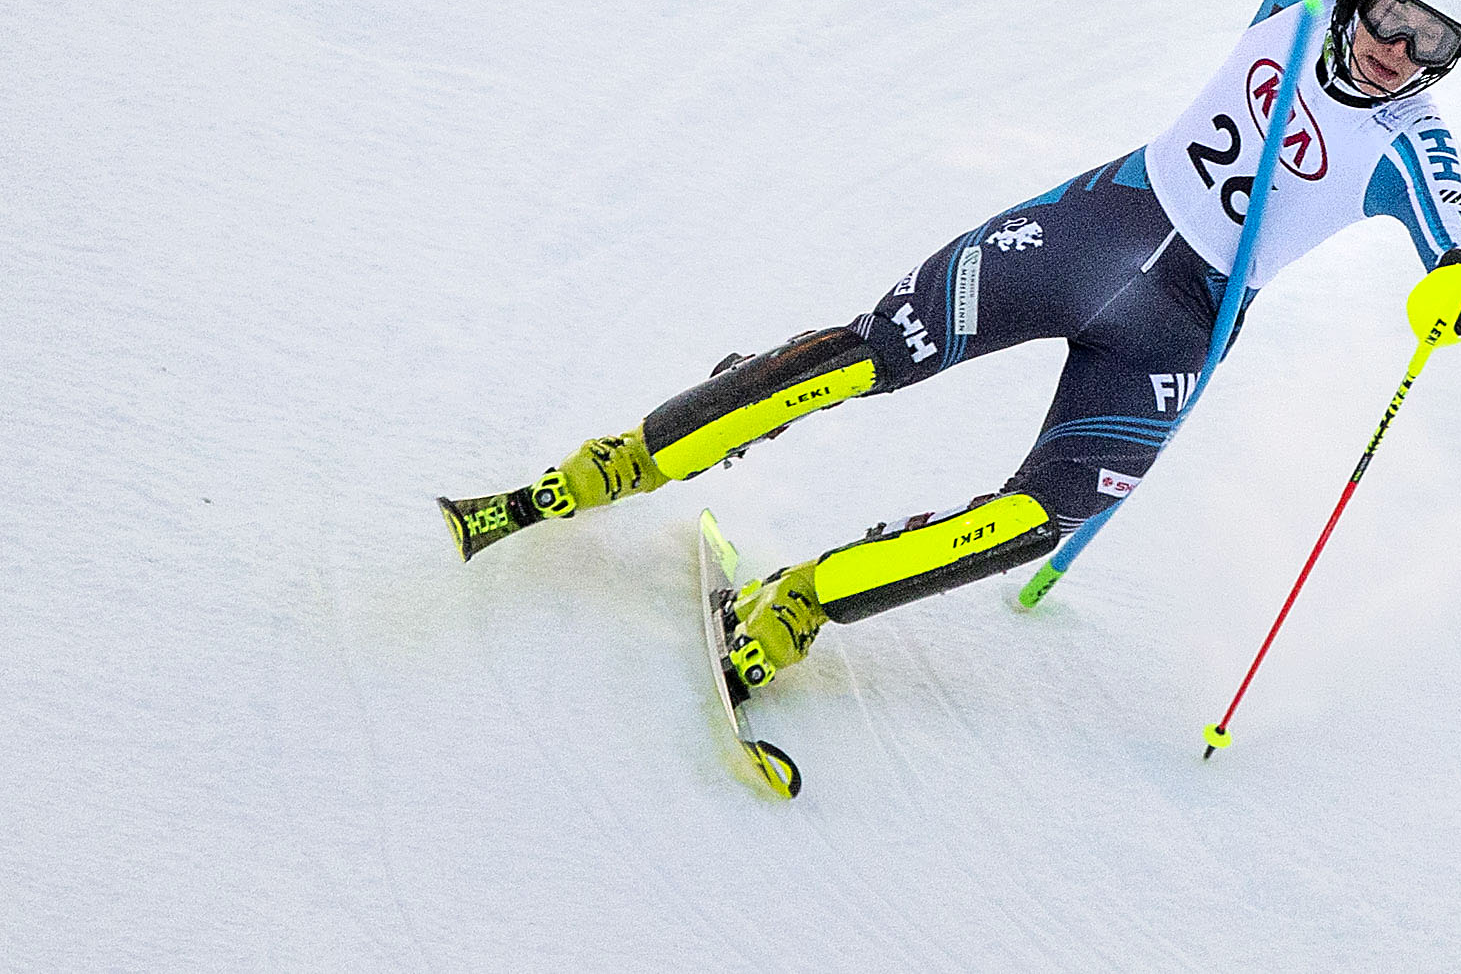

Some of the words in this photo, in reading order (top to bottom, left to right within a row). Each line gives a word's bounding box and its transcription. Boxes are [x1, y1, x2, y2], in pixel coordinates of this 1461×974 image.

[891, 302, 938, 363] HH
[1425, 319, 1447, 346] LEKI
[785, 386, 831, 407] LEKI
[953, 522, 995, 549] LEKI
